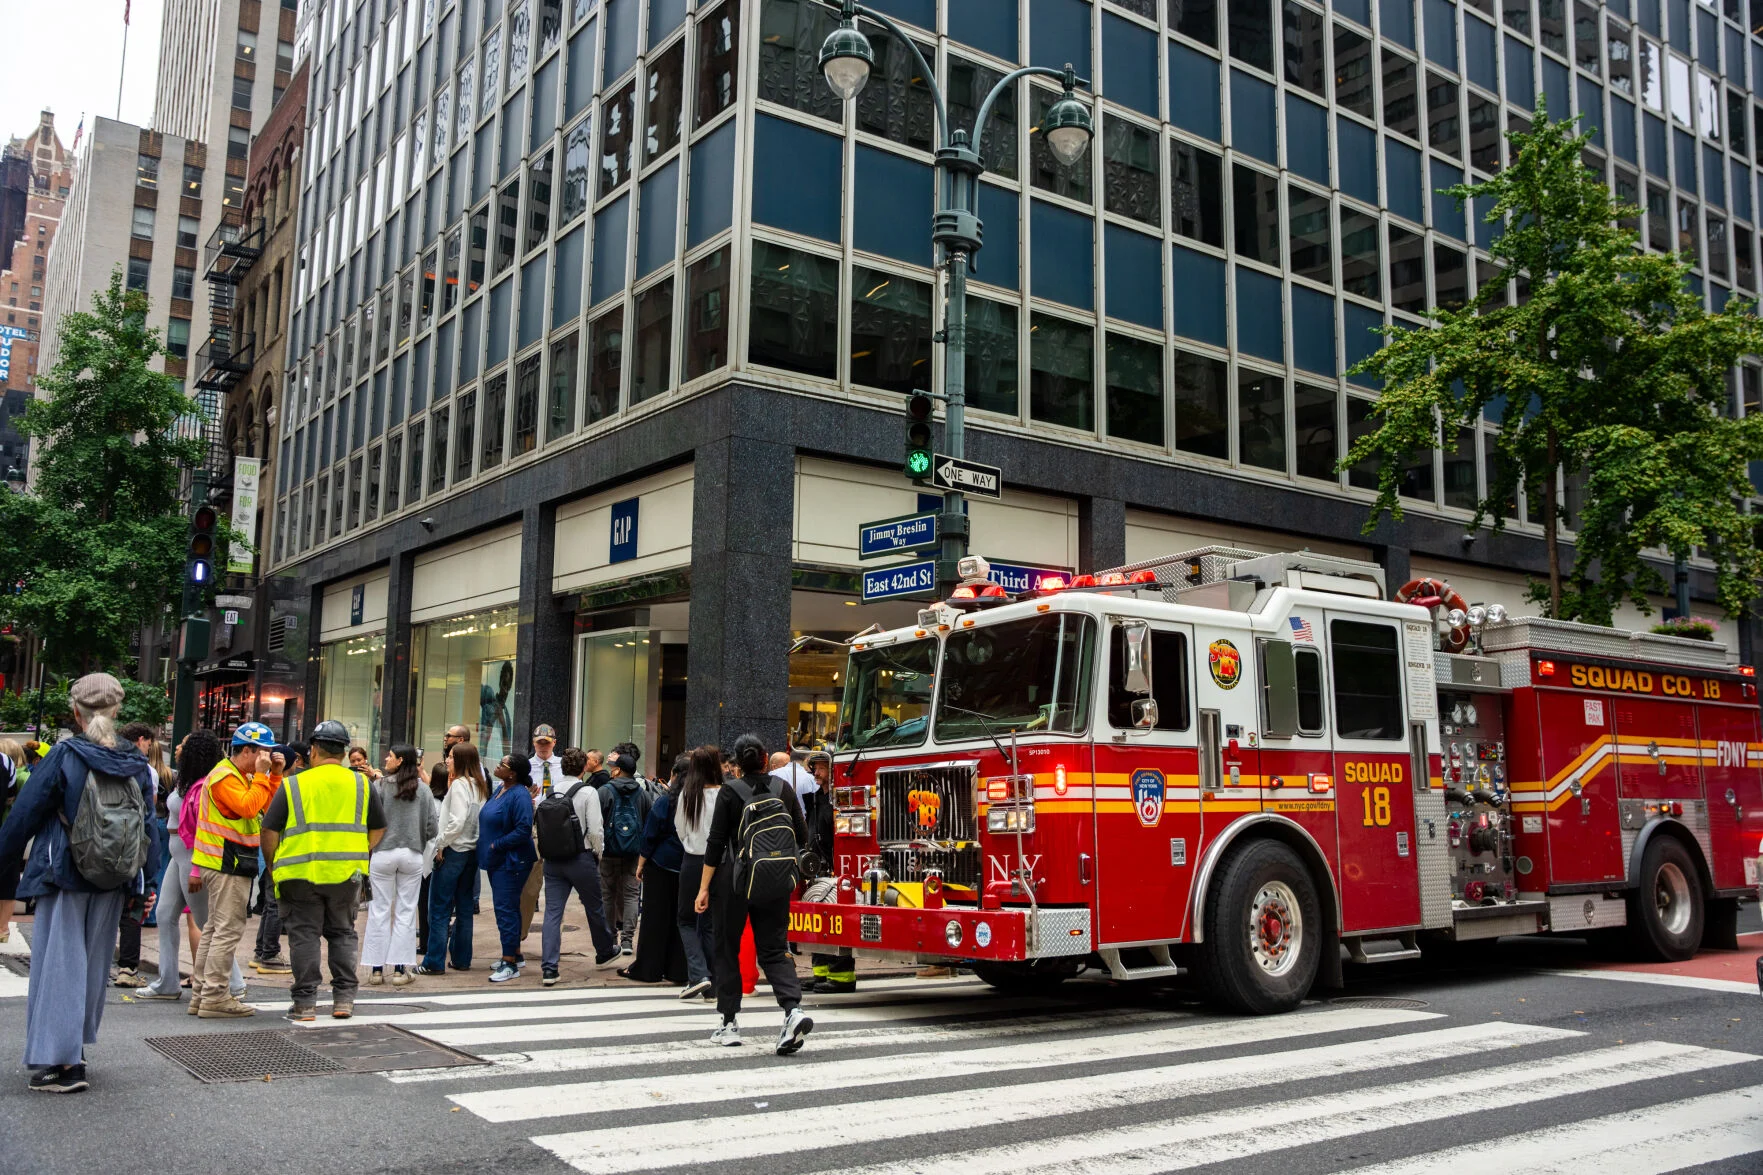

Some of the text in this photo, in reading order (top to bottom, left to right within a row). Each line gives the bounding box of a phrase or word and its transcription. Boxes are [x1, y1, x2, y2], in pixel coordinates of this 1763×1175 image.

[238, 463, 257, 476] FOOD
[944, 466, 993, 488] ONE WAY
[239, 495, 252, 508] FOR
[614, 516, 631, 546] GAP
[869, 521, 927, 544] Jimmy Breslin
[893, 537, 907, 547] Way
[867, 569, 932, 594] East 42nd St
[990, 570, 1029, 590] Third
[226, 612, 237, 624] EAT
[1209, 642, 1240, 663] SQUAD
[1571, 664, 1721, 699] SQUAD CO. 18
[1586, 702, 1602, 712] FAST
[1588, 713, 1602, 724] PAK
[1717, 740, 1747, 768] FDNY
[1344, 761, 1403, 784] SQUAD
[919, 803, 937, 828] 18
[1278, 802, 1330, 811] www.nyc.gov/fdny
[1361, 786, 1391, 827] 18
[830, 915, 843, 935] 18
